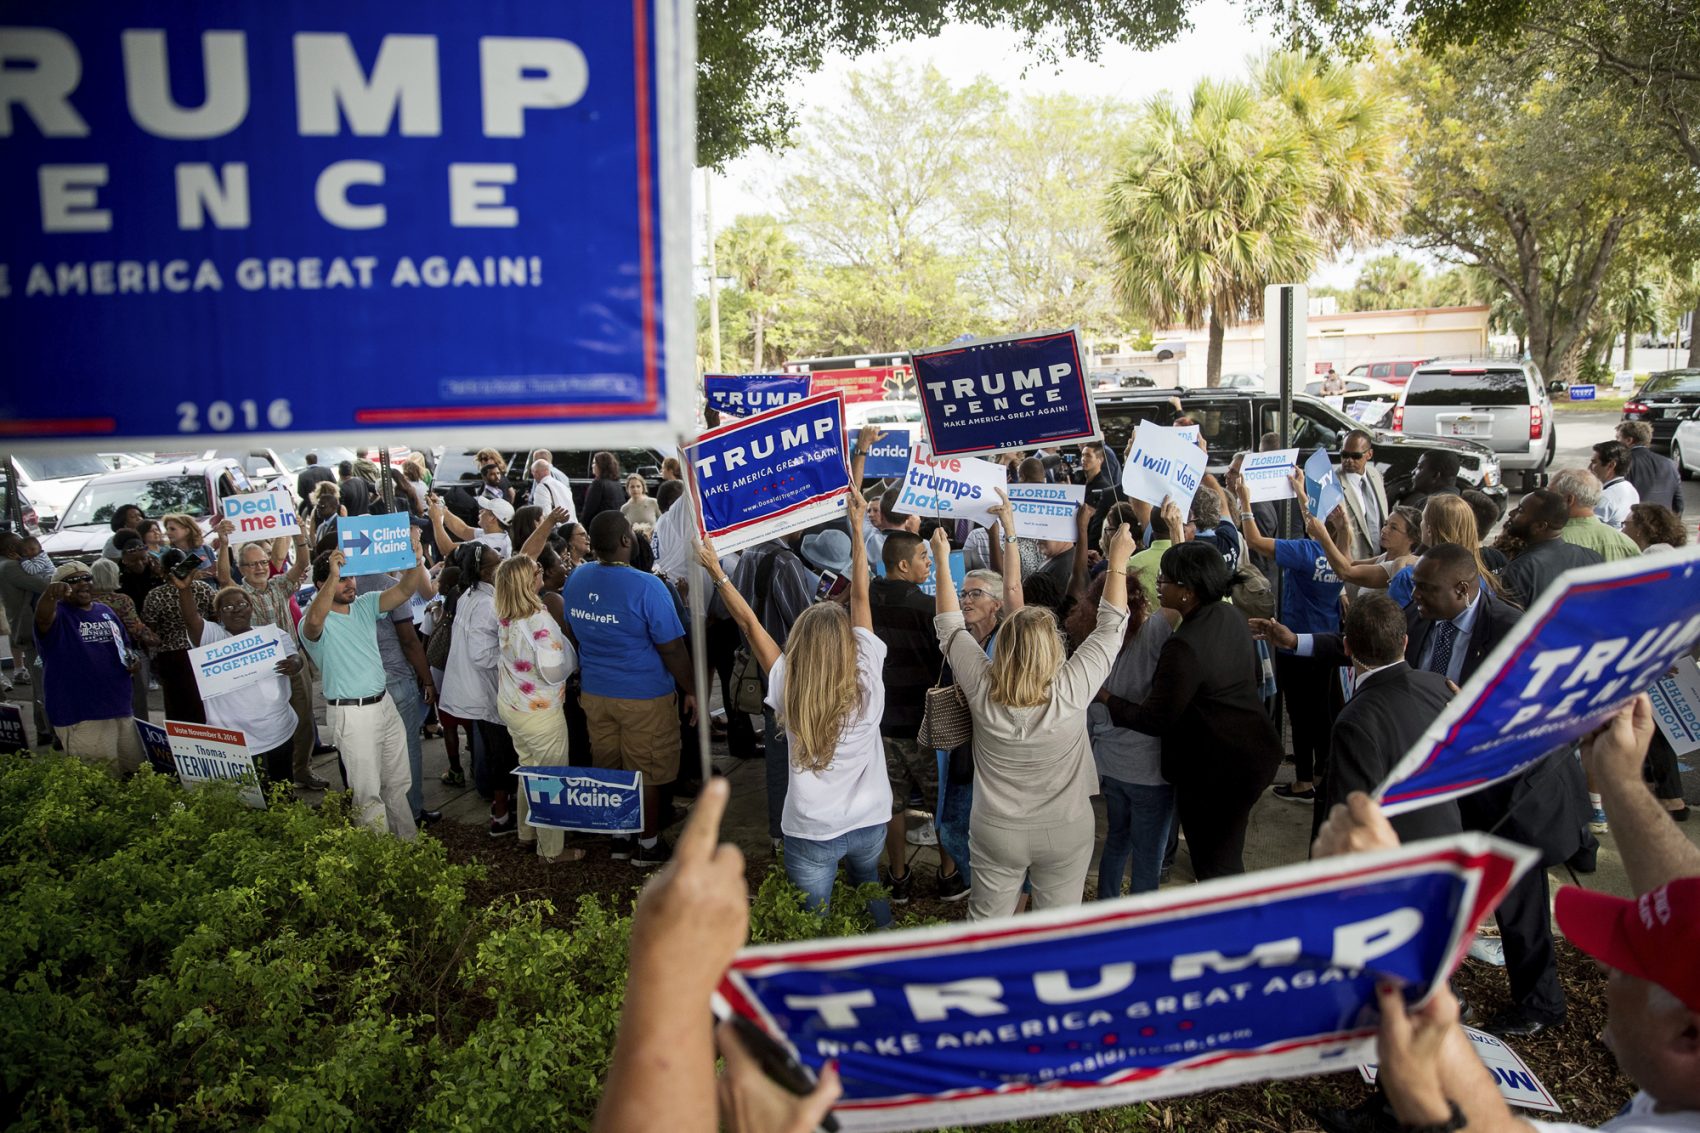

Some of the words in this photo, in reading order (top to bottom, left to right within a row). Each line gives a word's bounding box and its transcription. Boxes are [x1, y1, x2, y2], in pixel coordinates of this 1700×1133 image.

[26, 259, 223, 297] AMERICA
[236, 256, 378, 291] GREAT
[391, 254, 542, 287] AGAIN!
[926, 362, 1072, 401] TRUMP
[712, 391, 802, 406] TRUMP
[943, 388, 1062, 417] PENCE
[177, 398, 293, 432] 2016
[943, 419, 967, 428] MAKE
[968, 414, 1006, 426] AMERICA
[1007, 411, 1035, 420] GREAT
[1038, 404, 1068, 415] AGAIN!
[694, 416, 834, 479] TRUMP
[868, 444, 908, 458] lorida
[1000, 439, 1024, 448] 2016
[703, 482, 730, 498] MAKE
[732, 467, 774, 490] AMERICA
[776, 455, 804, 472] GREAT
[807, 445, 840, 463] AGAIN!
[1132, 448, 1142, 464] I
[1142, 454, 1171, 476] will
[1250, 454, 1286, 466] FLORIDA
[909, 466, 982, 500] trumps
[1008, 488, 1067, 500] FLORIDA
[224, 493, 277, 517] Deal
[900, 486, 953, 512] hate.
[1010, 502, 1073, 517] OGETHER
[240, 514, 277, 533] me
[279, 508, 298, 527] in
[373, 540, 407, 554] Kaine
[570, 607, 620, 624] #WeAreFL
[205, 634, 264, 660] FLORIDA
[202, 647, 276, 678] TOGETHER
[1499, 660, 1664, 734] PENC
[1647, 684, 1685, 740] FLORIDA
[173, 726, 188, 735] Vote
[188, 728, 218, 739] November
[223, 733, 238, 742] 2016
[194, 744, 227, 759] Thomas
[566, 788, 623, 808] Kaine
[783, 906, 1424, 1029] TRUMP
[935, 1009, 1113, 1050] AMERICA
[1126, 981, 1254, 1019] GREAT
